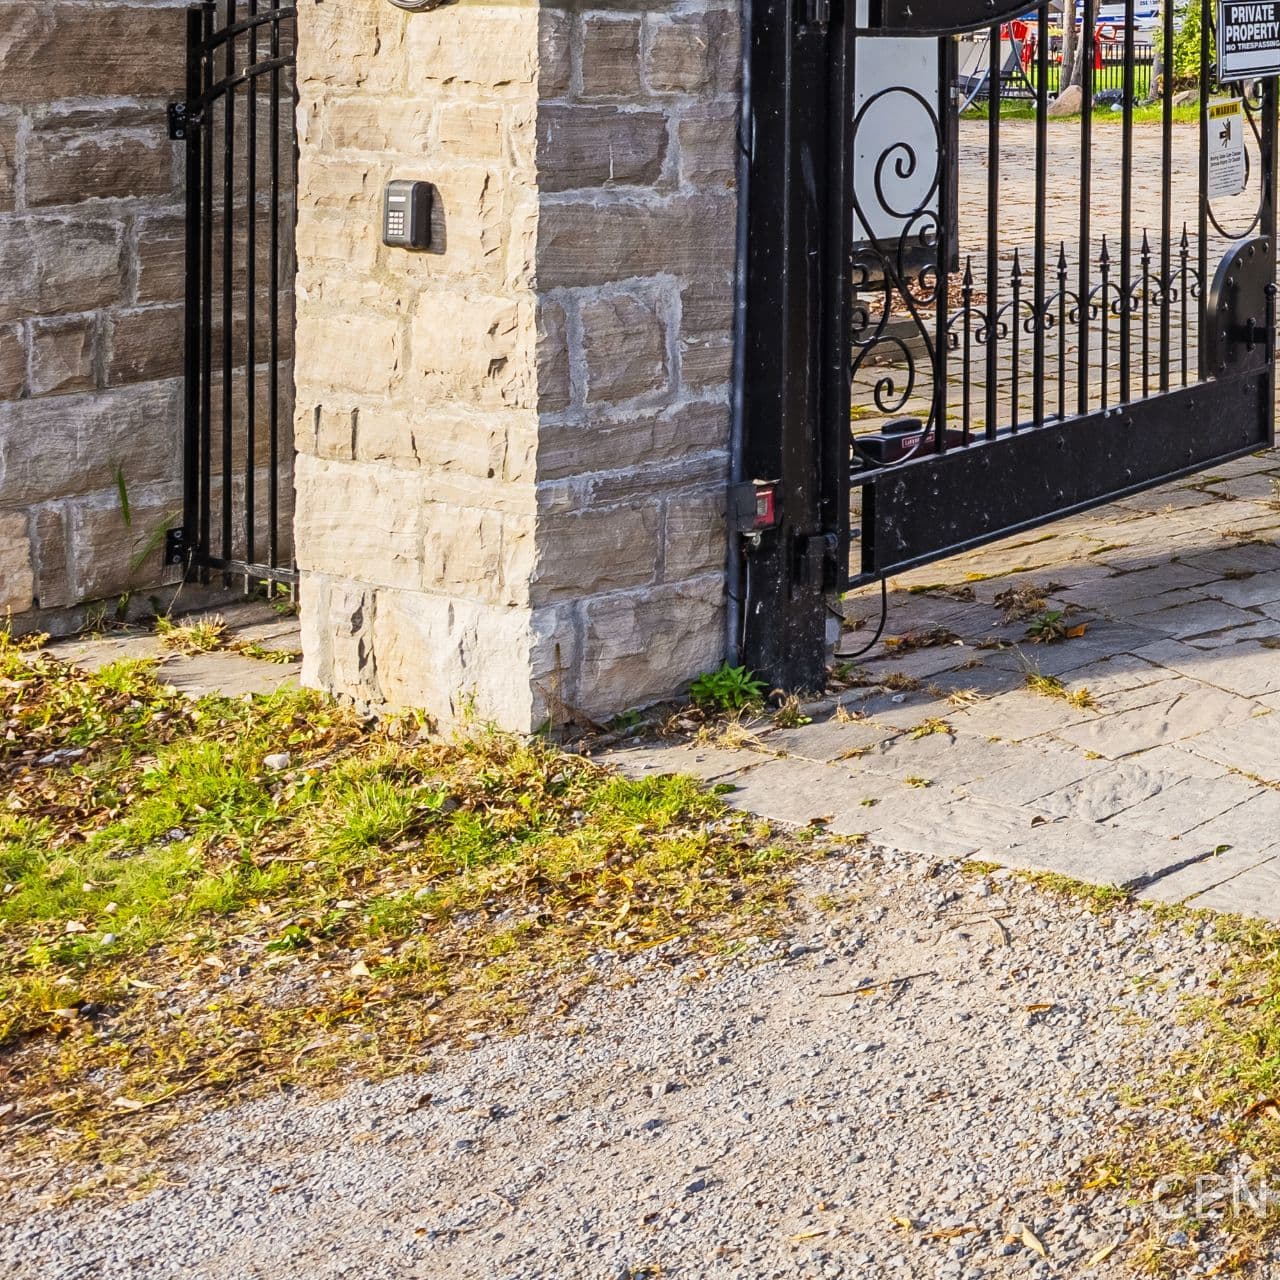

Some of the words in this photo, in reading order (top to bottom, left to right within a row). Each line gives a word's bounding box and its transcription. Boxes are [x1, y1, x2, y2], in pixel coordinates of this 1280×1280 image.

[1231, 4, 1275, 23] PRIVATE
[1226, 22, 1280, 42] PROPERTY
[1225, 43, 1236, 51] NO
[1238, 40, 1280, 50] TRESPASSING
